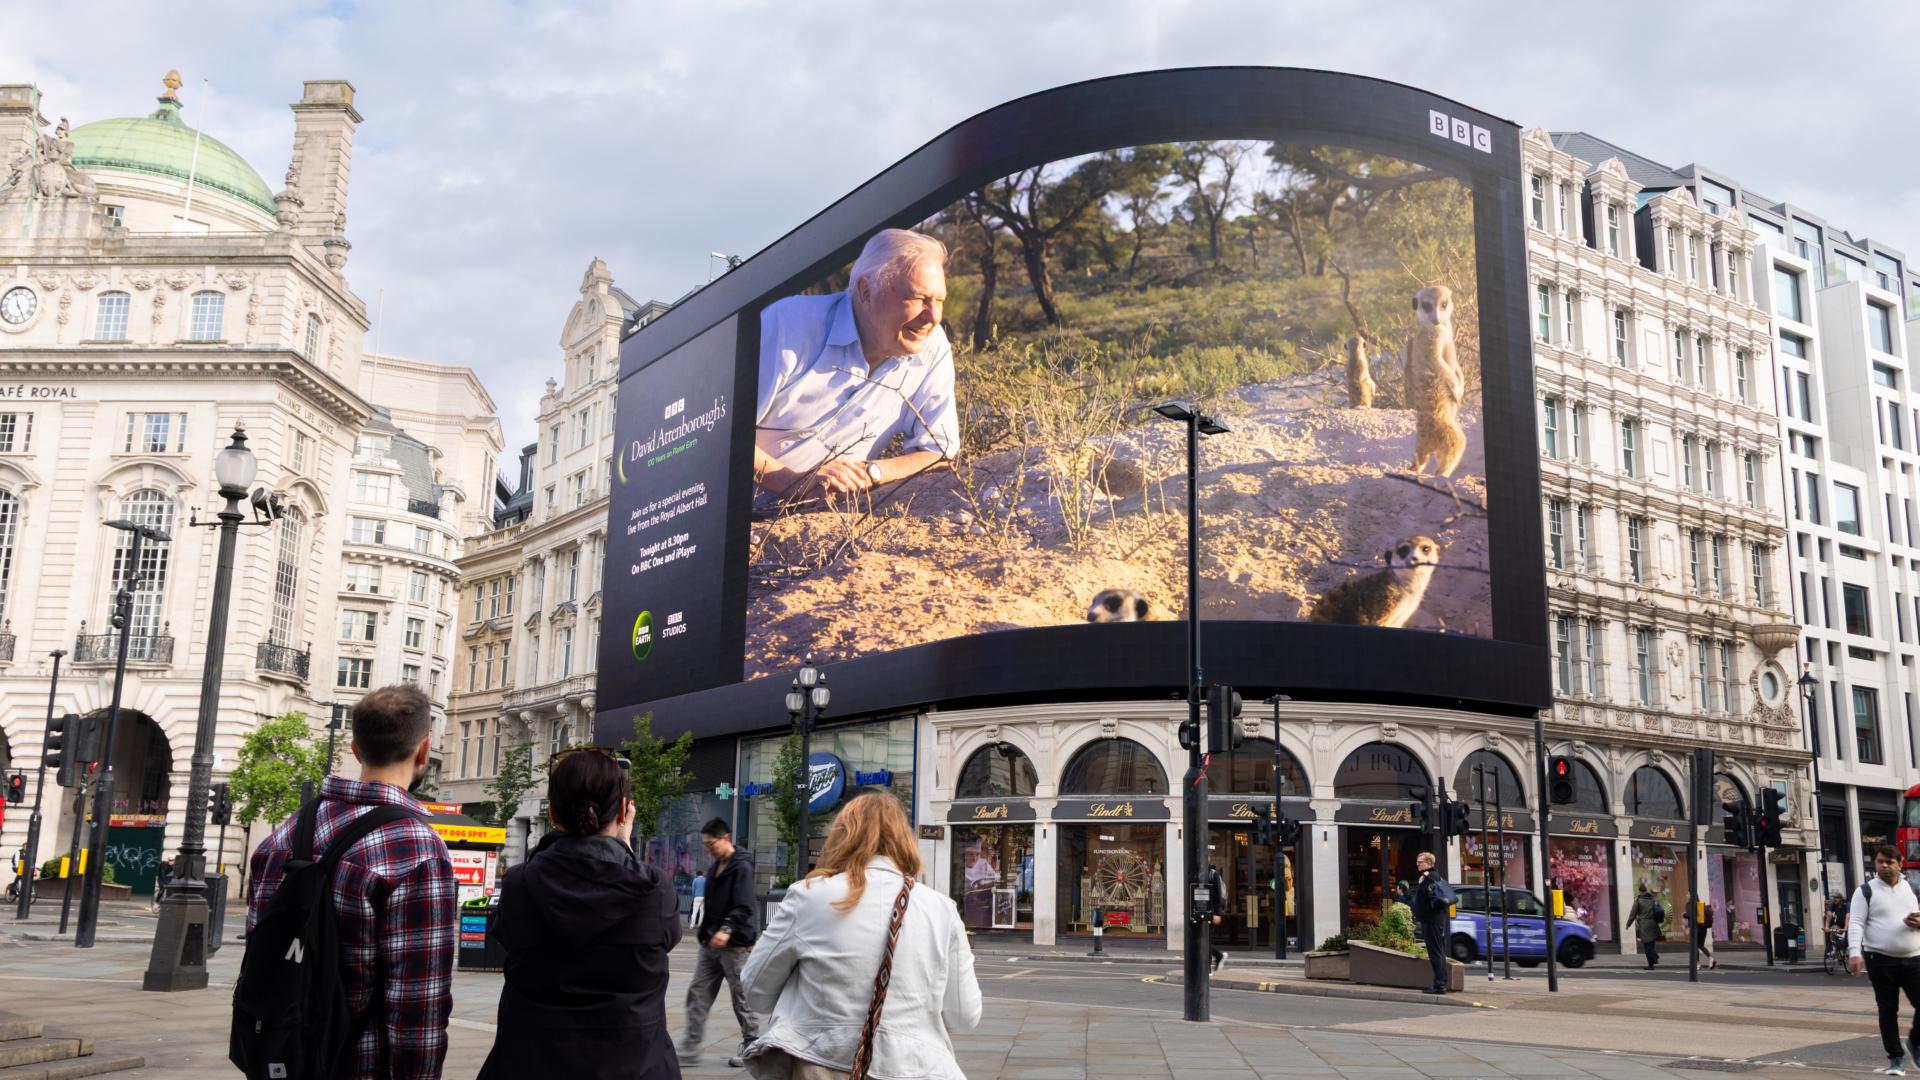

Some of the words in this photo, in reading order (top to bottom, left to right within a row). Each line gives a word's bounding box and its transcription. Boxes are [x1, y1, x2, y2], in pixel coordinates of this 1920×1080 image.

[1432, 112, 1489, 151] BBC
[0, 384, 24, 398] AFÉ
[31, 386, 77, 398] ROYAL
[277, 392, 301, 415] ALLIANCE
[305, 409, 315, 423] LIFE
[318, 419, 334, 435] OFFICE
[665, 398, 684, 419] BBC
[631, 430, 656, 461] David
[656, 396, 726, 448] Attenborough's
[647, 459, 655, 467] 100
[655, 453, 666, 464] Years
[666, 450, 673, 459] on
[672, 445, 686, 455] Planet
[685, 438, 698, 449] Earth
[631, 508, 642, 520] Join
[642, 505, 648, 516] us
[649, 502, 657, 512] for
[658, 500, 661, 509] a
[662, 489, 681, 508] special
[681, 482, 706, 498] evening,
[627, 525, 637, 535] live
[637, 519, 650, 531] from
[650, 515, 660, 526] the
[660, 506, 676, 522] Royal
[676, 499, 694, 516] Albert
[695, 493, 708, 508] Hall
[640, 542, 660, 558] Tonight
[660, 539, 668, 550] at
[667, 532, 689, 547] 8.30pm
[631, 564, 640, 575] On
[640, 558, 652, 572] BBC
[652, 557, 664, 567] One
[664, 549, 675, 563] and
[675, 544, 697, 559] iPlayer
[662, 623, 687, 638] STUDIOS
[635, 633, 651, 646] EARTH
[35, 669, 103, 677] ALIANCE
[855, 768, 892, 787] beauty
[972, 805, 1000, 819] Lindt
[1086, 803, 1124, 817] Lindt
[1228, 803, 1261, 818] Lin
[1369, 807, 1404, 822] Lindt
[450, 829, 466, 837] DOG
[468, 830, 487, 838] SPOT
[1569, 820, 1594, 833] Lindt
[1649, 825, 1672, 838] Lindt
